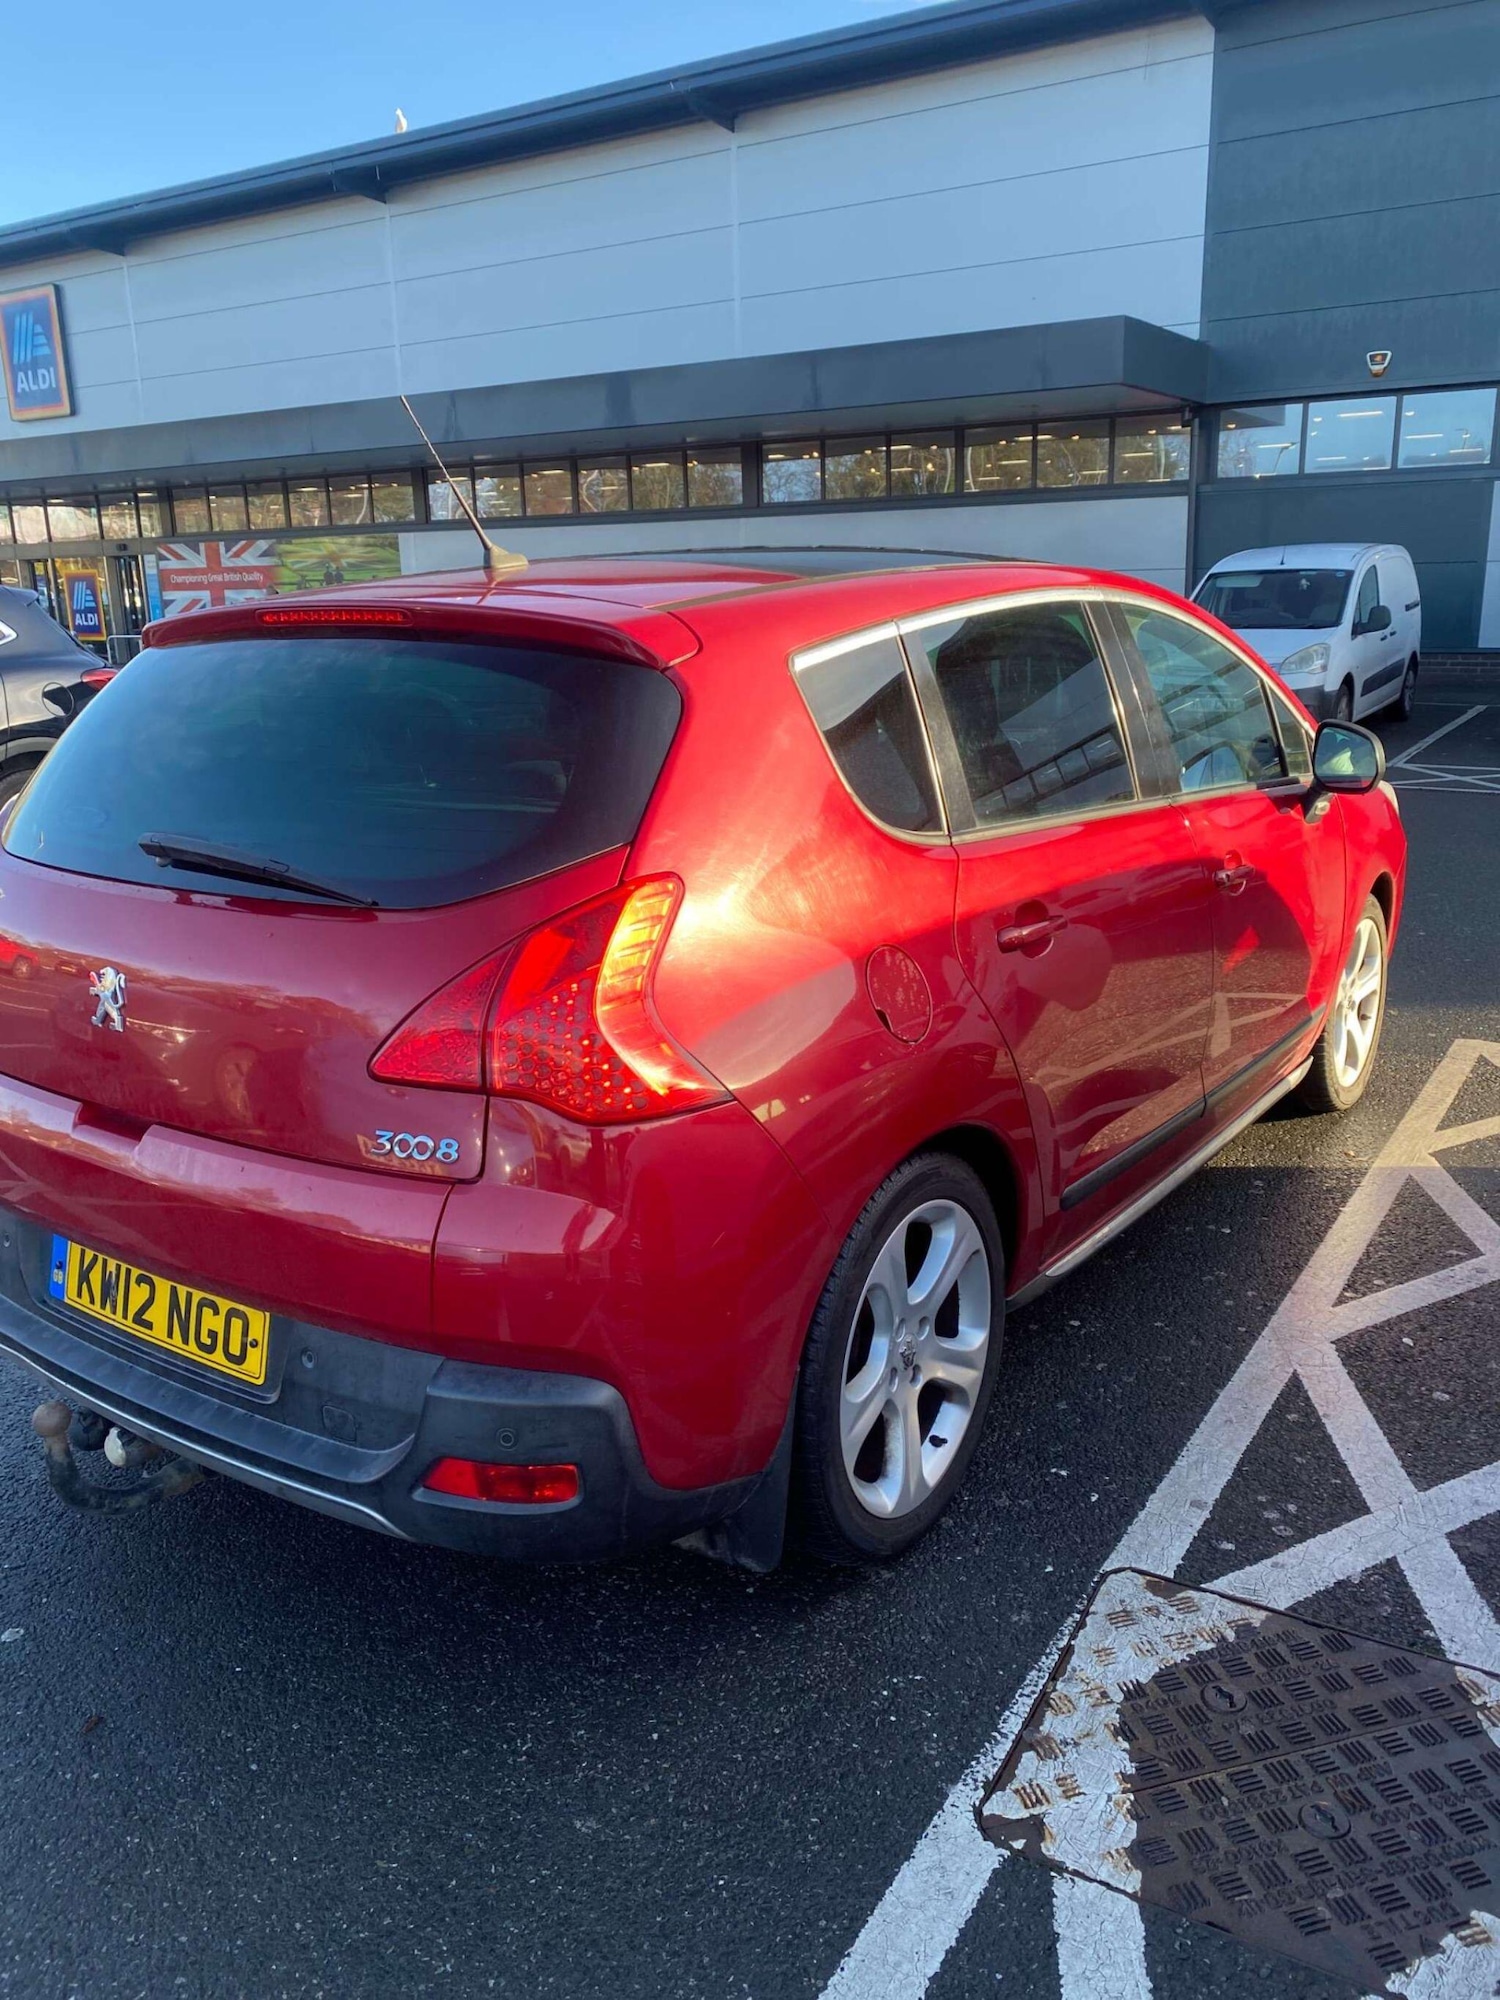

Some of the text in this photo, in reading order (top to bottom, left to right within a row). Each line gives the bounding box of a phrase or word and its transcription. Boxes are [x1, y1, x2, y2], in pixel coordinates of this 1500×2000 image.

[17, 366, 56, 393] ALDI
[170, 571, 263, 584] Championing Great British Quality
[75, 613, 98, 626] ALDI
[370, 1129, 459, 1163] 3008
[53, 1269, 63, 1285] GB
[76, 1248, 249, 1366] KW12 NGO
